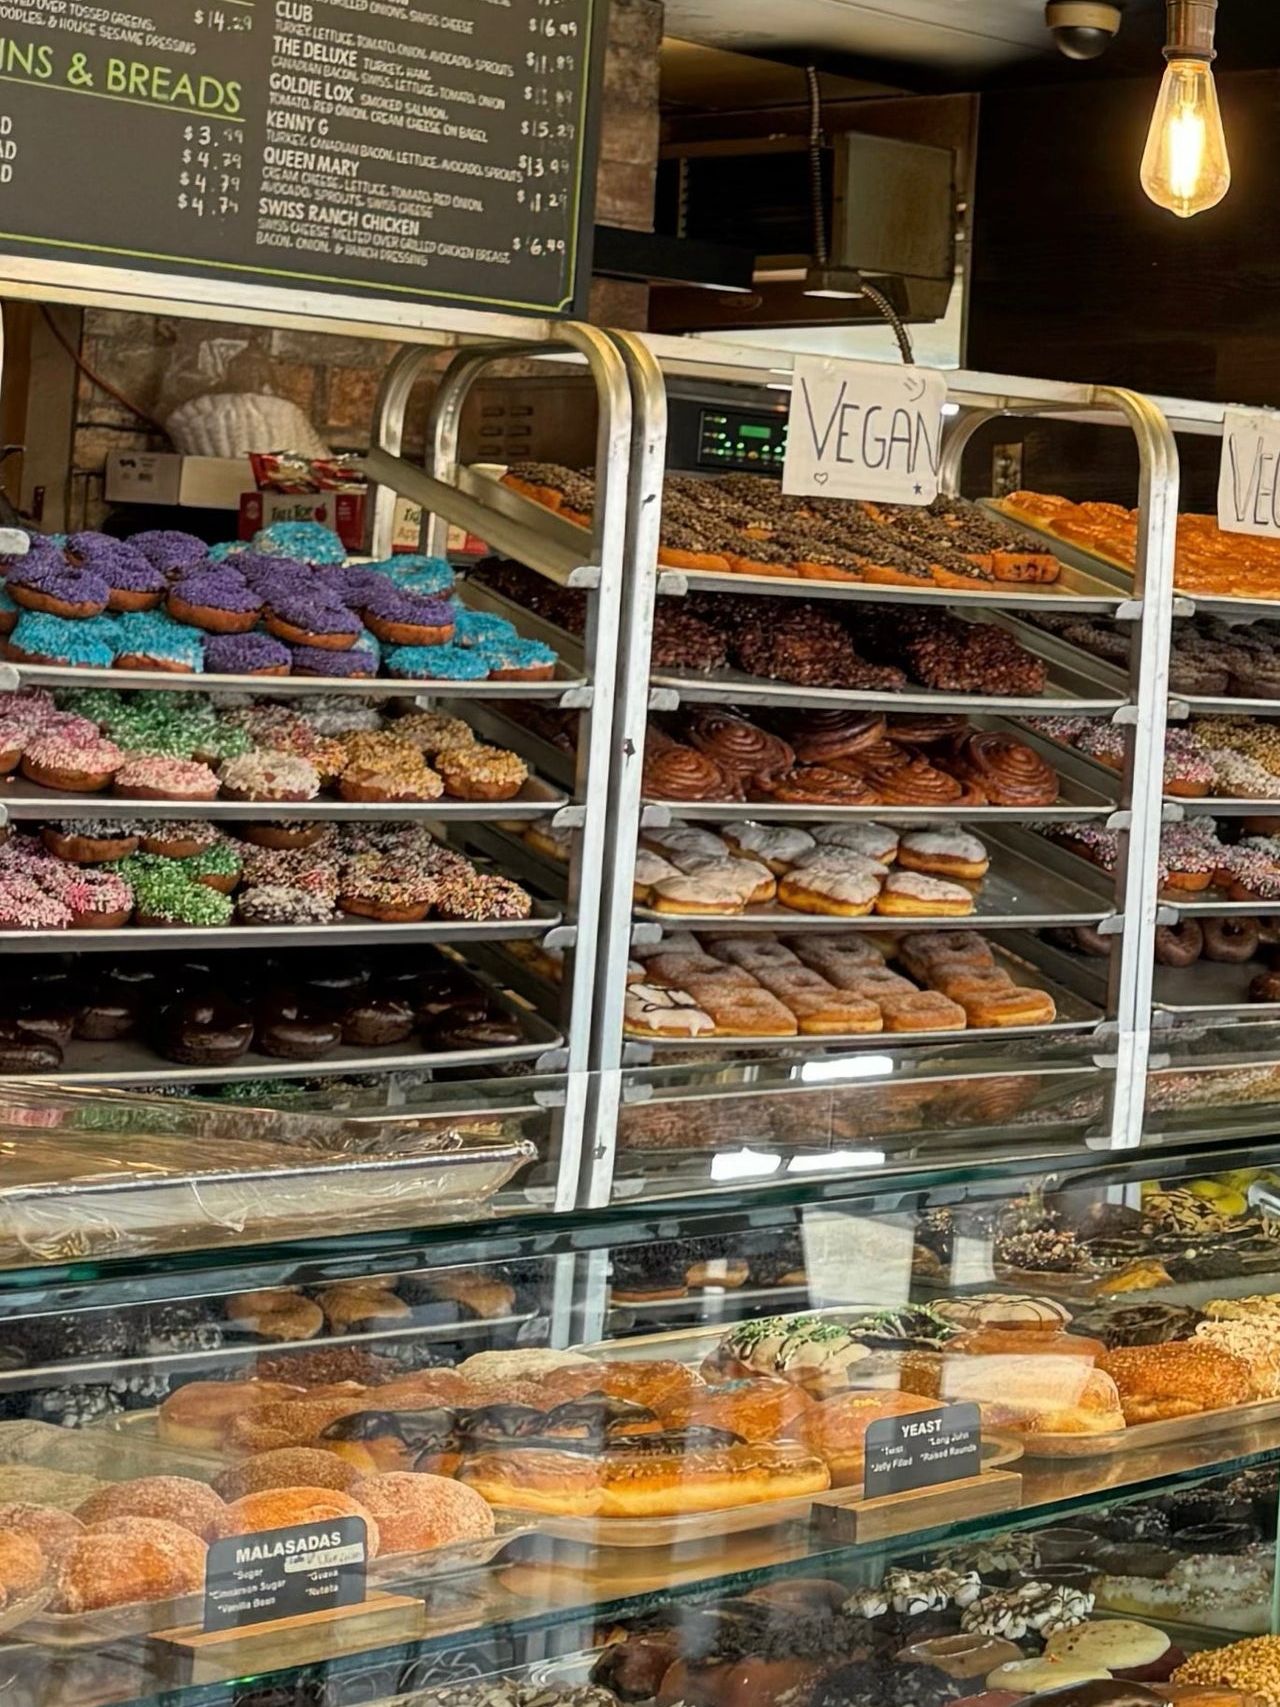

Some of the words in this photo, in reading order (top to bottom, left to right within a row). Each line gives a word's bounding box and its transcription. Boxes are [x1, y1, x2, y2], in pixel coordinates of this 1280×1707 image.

[69, 2, 110, 23] TOSSED
[275, 0, 313, 23] CLUB
[59, 17, 97, 37] HOUSE
[99, 24, 143, 46] SESAME
[273, 35, 301, 57] THE
[303, 41, 358, 68] DELUXE
[66, 52, 95, 87] &
[106, 57, 243, 114] BREADS
[269, 72, 322, 98] GOLDIE
[324, 82, 355, 104] LOX
[359, 93, 403, 112] SMOKED
[266, 109, 316, 133] KENNY
[318, 118, 329, 135] G
[263, 146, 314, 170] QUEEN
[316, 155, 360, 178] MARY
[258, 197, 305, 220] SWISS
[308, 204, 359, 228] RANCH
[361, 213, 420, 236] CHICKEN
[800, 376, 943, 477] VEGAN
[901, 1419, 942, 1438] YEAST
[236, 1531, 341, 1564] MALASADAS
